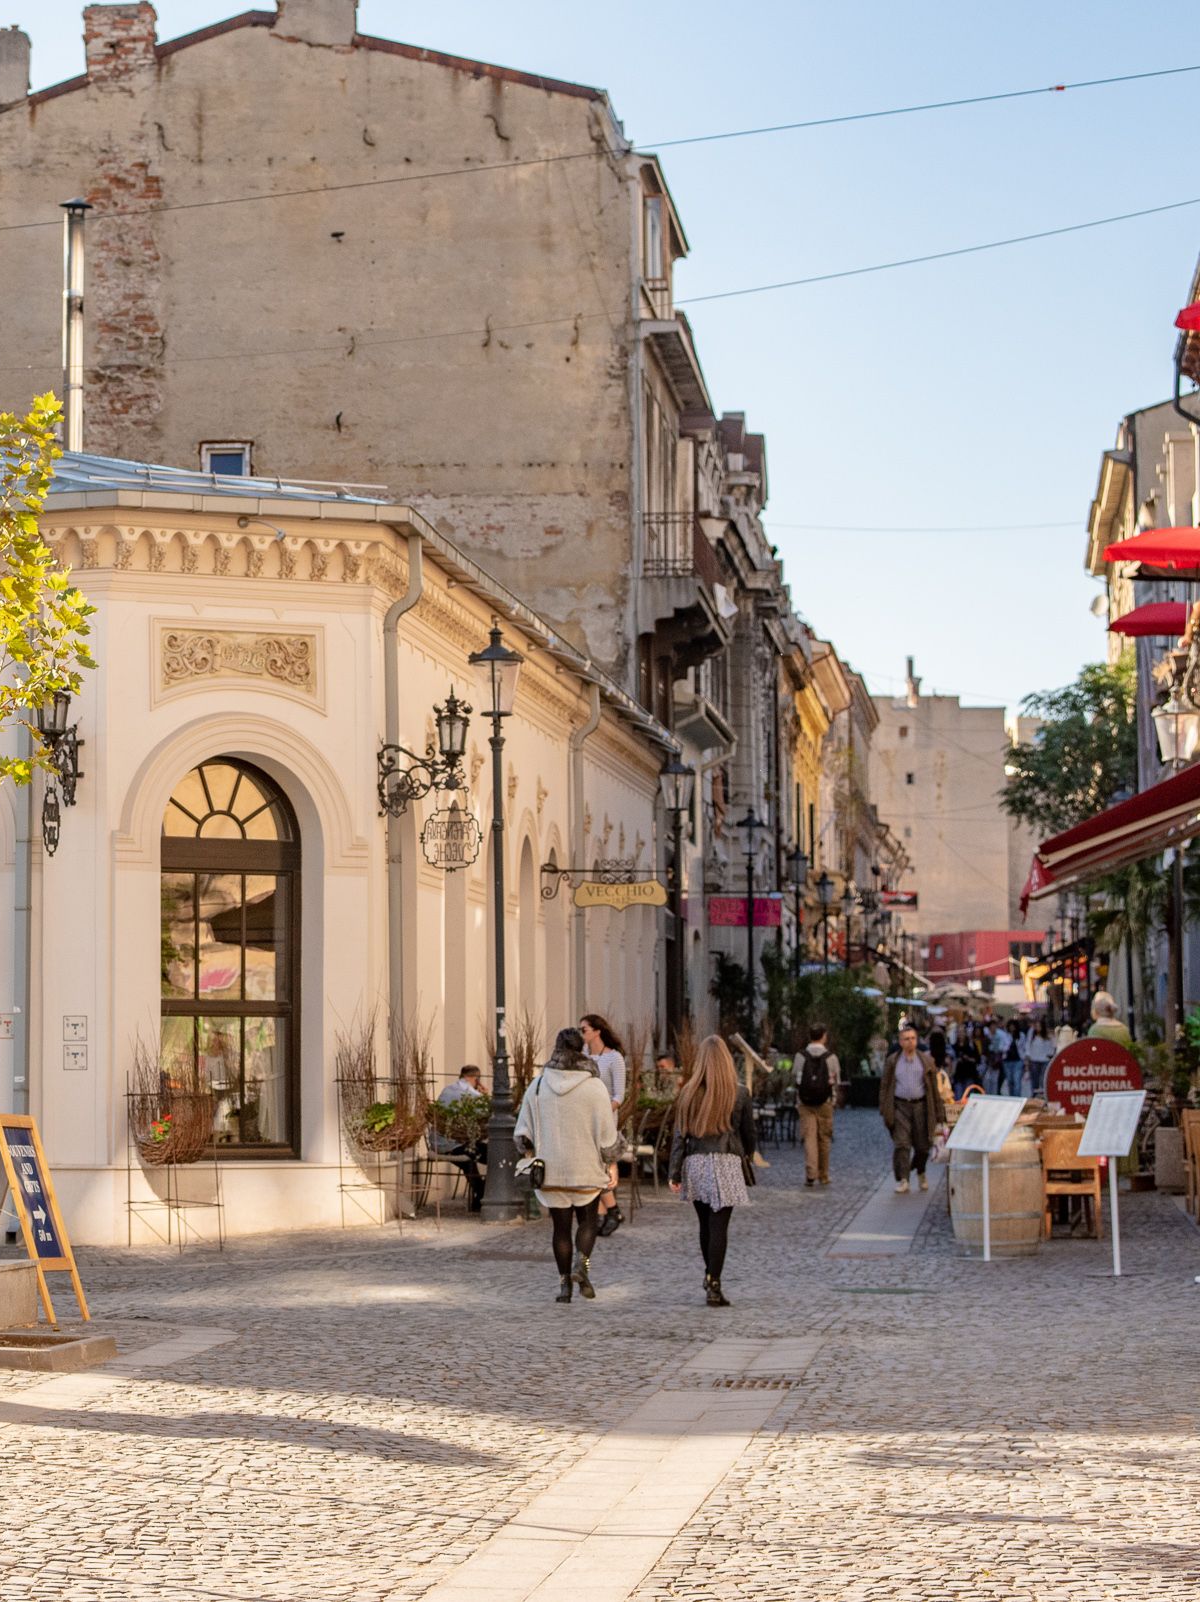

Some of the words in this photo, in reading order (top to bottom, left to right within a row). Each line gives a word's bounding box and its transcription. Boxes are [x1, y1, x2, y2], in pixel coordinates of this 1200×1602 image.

[585, 885, 655, 897] VECCHIO
[21, 1163, 33, 1174] AND
[38, 1230, 46, 1241] 50
[46, 1232, 52, 1241] m
